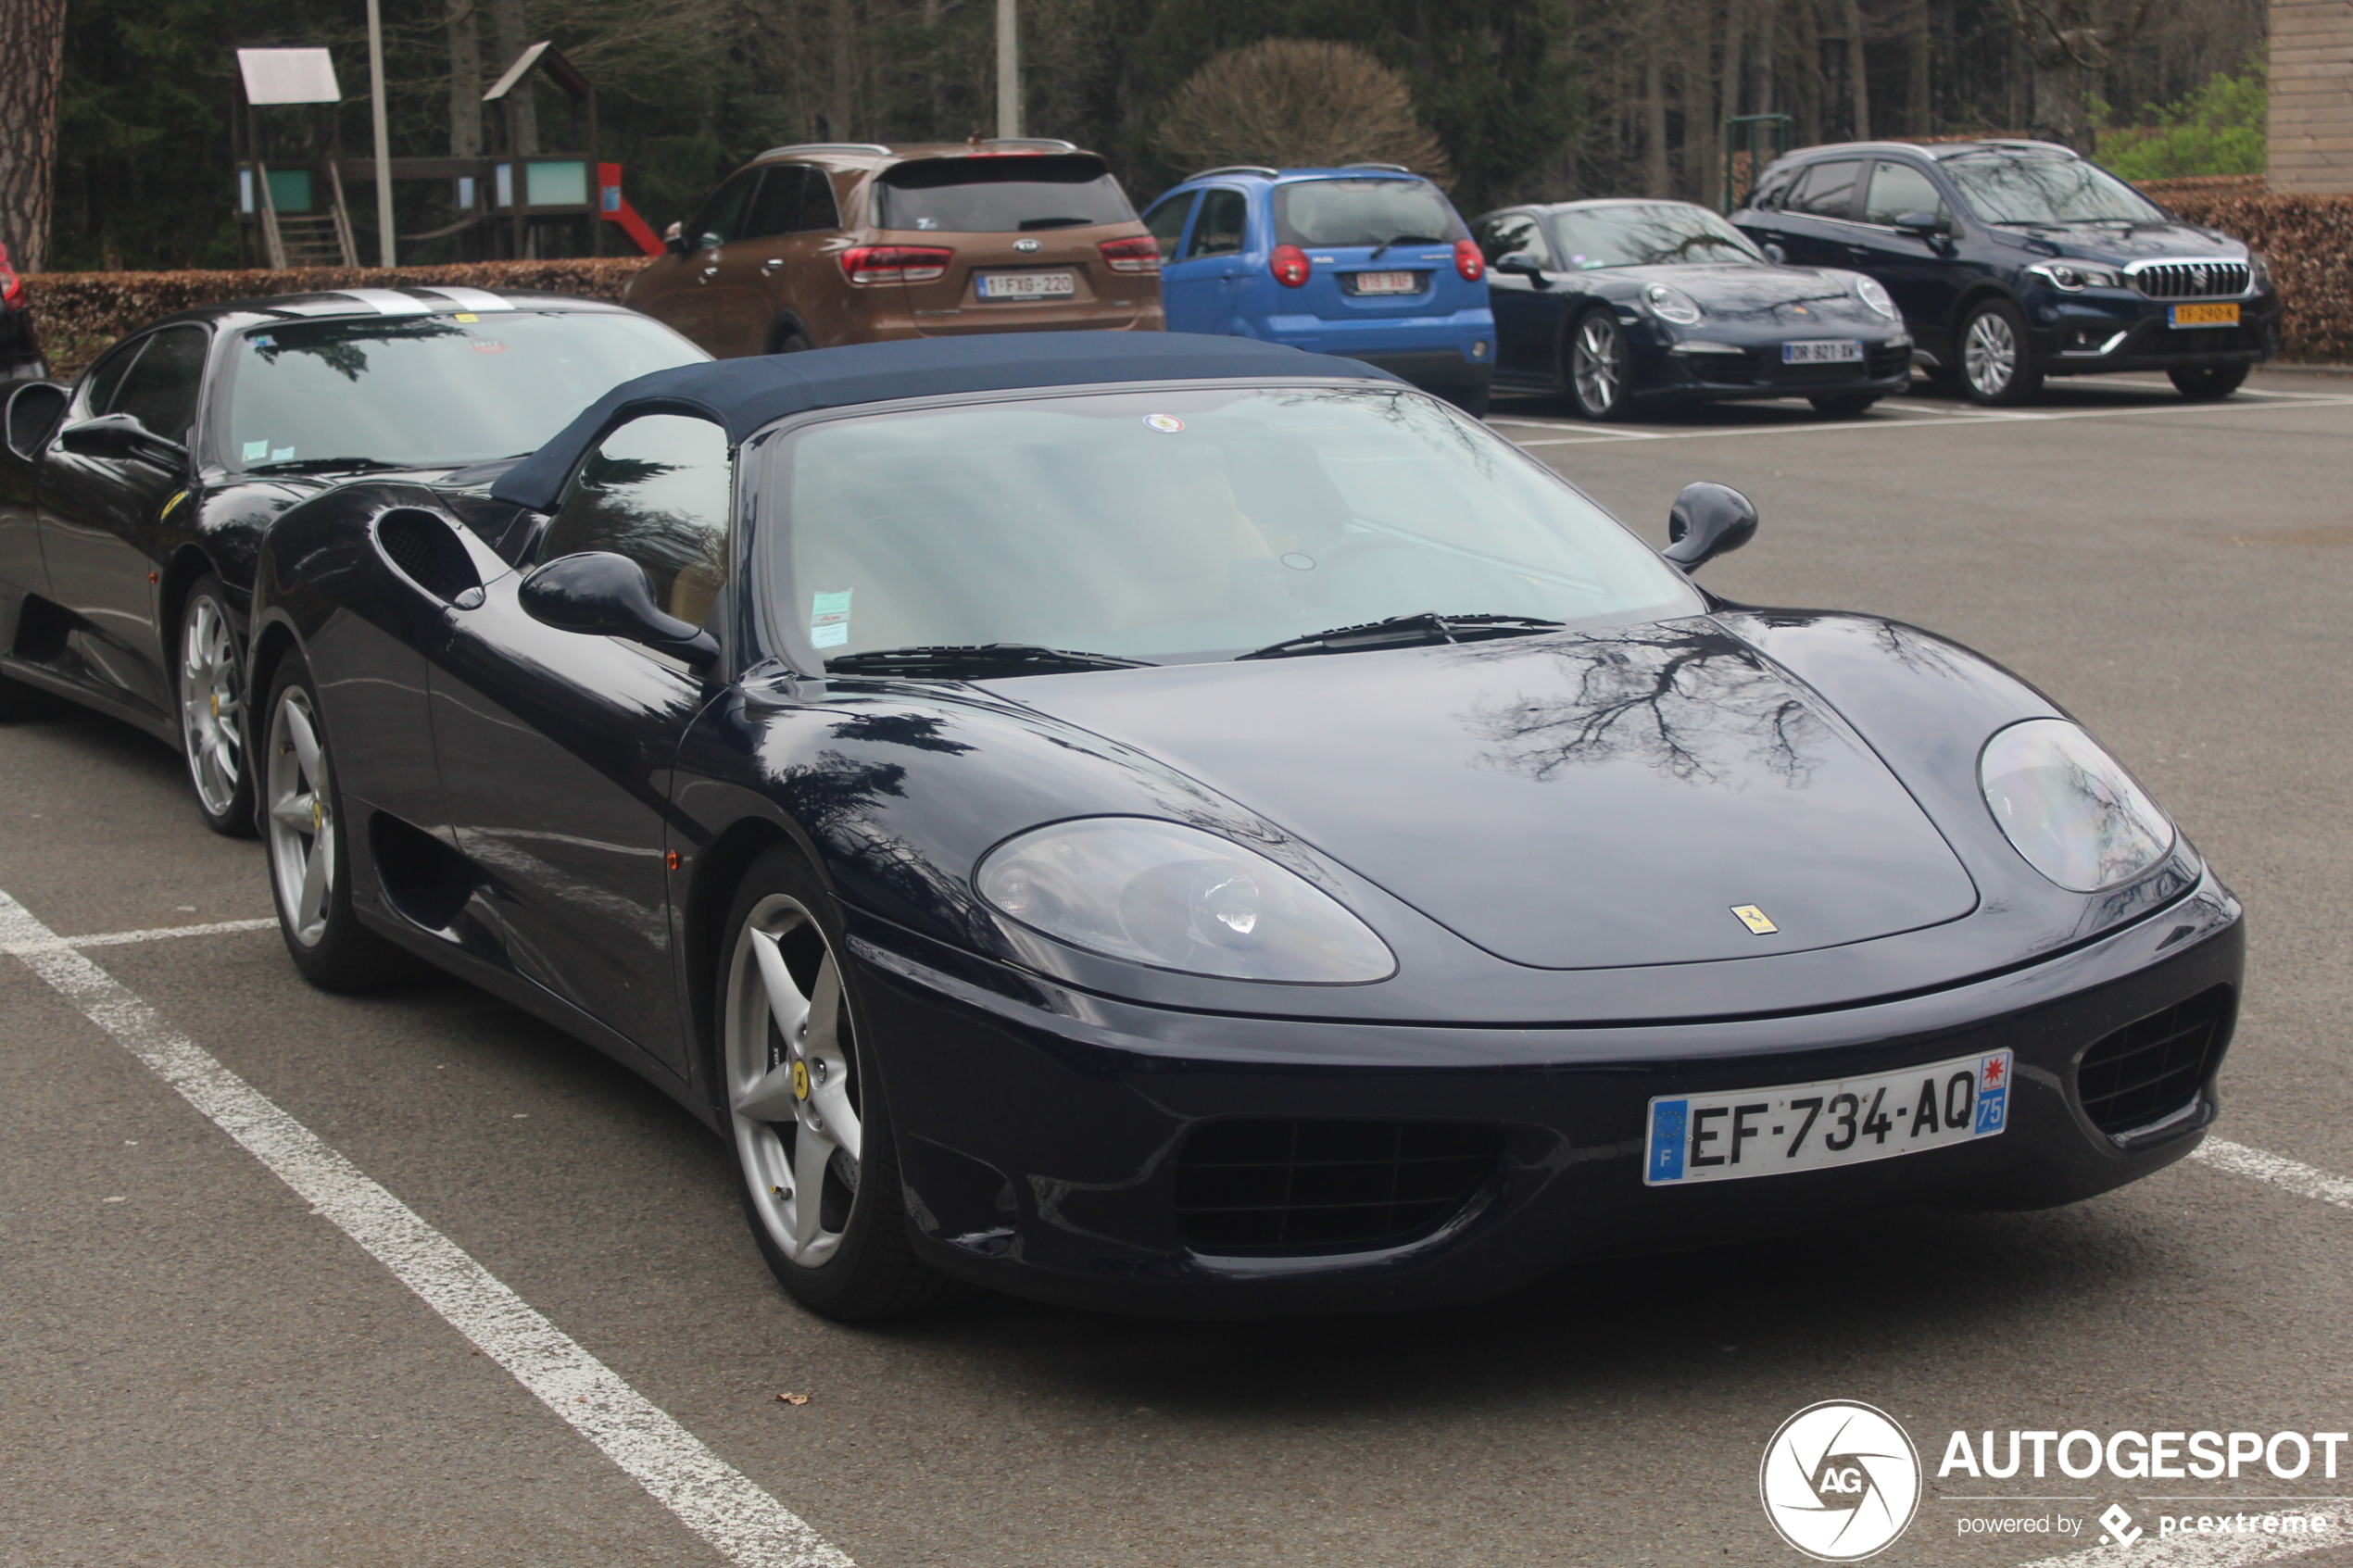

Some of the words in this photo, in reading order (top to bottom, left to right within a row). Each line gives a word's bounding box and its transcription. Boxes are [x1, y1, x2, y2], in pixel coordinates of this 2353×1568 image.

[1690, 1071, 1974, 1167] EF-734-AQ
[1979, 1097, 2003, 1126] 75
[1660, 1149, 1671, 1167] F
